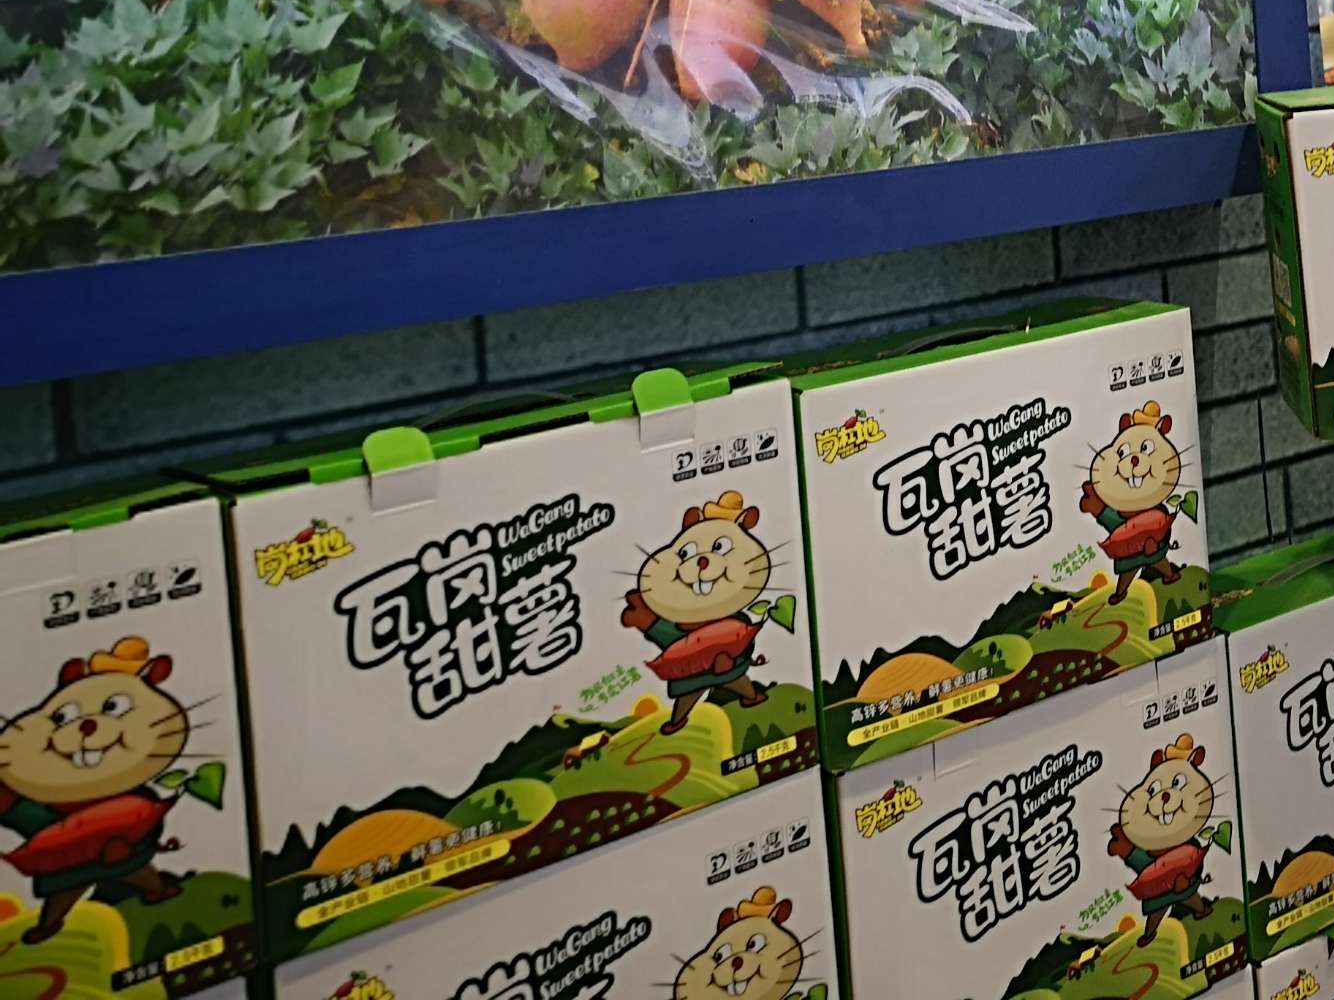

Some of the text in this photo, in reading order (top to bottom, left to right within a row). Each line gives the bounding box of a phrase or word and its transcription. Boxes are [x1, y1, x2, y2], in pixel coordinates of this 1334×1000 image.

[988, 401, 1043, 442] WaGang
[497, 498, 575, 549] WaGang
[879, 428, 989, 531] 瓦岗
[932, 454, 1050, 576] 甜薯
[340, 528, 497, 664] 瓦岗
[409, 559, 578, 715] 甜薯
[1020, 747, 1076, 795] WaGang
[913, 780, 1020, 898] 瓦岗
[962, 799, 1078, 939] 甜薯
[535, 915, 612, 976] WaGang
